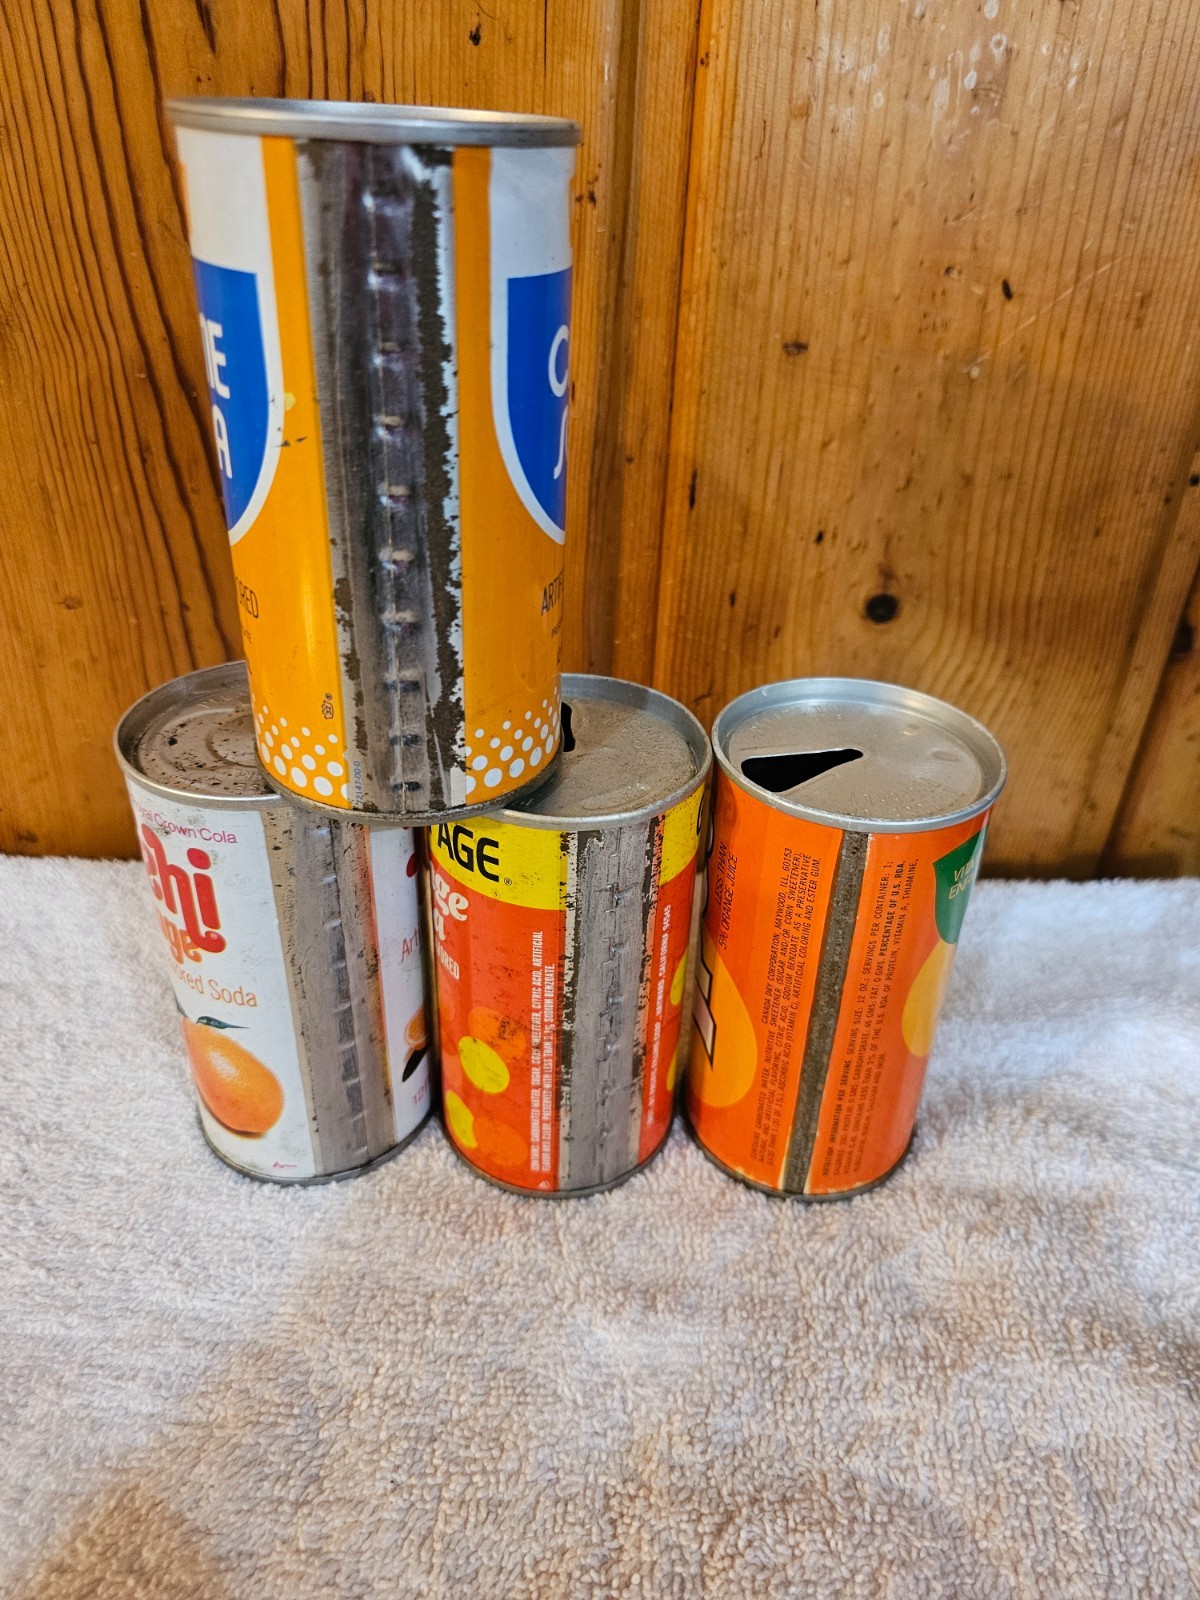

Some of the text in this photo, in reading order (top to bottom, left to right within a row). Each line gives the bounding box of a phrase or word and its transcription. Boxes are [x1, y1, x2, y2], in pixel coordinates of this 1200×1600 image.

[236, 577, 259, 618] RED
[155, 813, 197, 839] Crown
[200, 828, 238, 844] Cola
[782, 847, 792, 871] 60153
[811, 857, 821, 877] GUM.
[715, 841, 727, 905] LESS THAN
[796, 853, 811, 909] PRESERVATIVE
[807, 879, 817, 903] ESTER
[873, 873, 889, 918] CONTAINER:
[890, 880, 901, 896] U.S.
[718, 853, 738, 950] 5% ORANGE JUICE
[775, 892, 785, 929] MAYWOOD,
[784, 904, 793, 924] CORN
[804, 905, 813, 920] AND
[888, 898, 897, 907] OF
[899, 902, 909, 910] A,
[793, 921, 800, 931] AS
[869, 922, 880, 936] PER
[878, 911, 894, 956] PERCENTAGE
[892, 914, 906, 945] VITAMIN
[532, 931, 542, 966] ARTIFICIAL
[780, 928, 790, 956] AND/OR
[787, 934, 798, 970] BENZOATE
[799, 922, 810, 958] COLORING
[768, 932, 780, 981] CORPORATION,
[862, 940, 876, 974] SERVINGS
[884, 947, 898, 980] PROTEIN,
[532, 969, 542, 985] ACID,
[544, 964, 554, 996] BENZOATE.
[776, 959, 785, 984] (SUGAR
[793, 961, 804, 998] ARTIFICIAL
[208, 979, 258, 1007] Soda
[532, 987, 541, 1008] CITRIC
[765, 982, 773, 996] DRY
[783, 973, 792, 1000] SODIUM
[882, 983, 891, 992] OF
[543, 998, 553, 1021] SODIUM
[762, 998, 770, 1023] CANADA
[770, 987, 781, 1026] SWEETENER
[780, 1004, 788, 1022] ACID,
[878, 995, 888, 1008] RDA
[776, 1024, 784, 1047] CITRIC
[786, 1010, 796, 1041] (VITAMIN
[871, 1027, 881, 1039] THE
[543, 1041, 552, 1056] THAN
[765, 1029, 775, 1063] NUTRITIVE
[783, 1042, 791, 1058] ACID
[846, 1027, 858, 1054] SERVING
[869, 1042, 877, 1050] OF
[543, 1058, 552, 1071] LESS
[778, 1059, 789, 1090] ASCORBIC
[836, 1089, 845, 1100] PER
